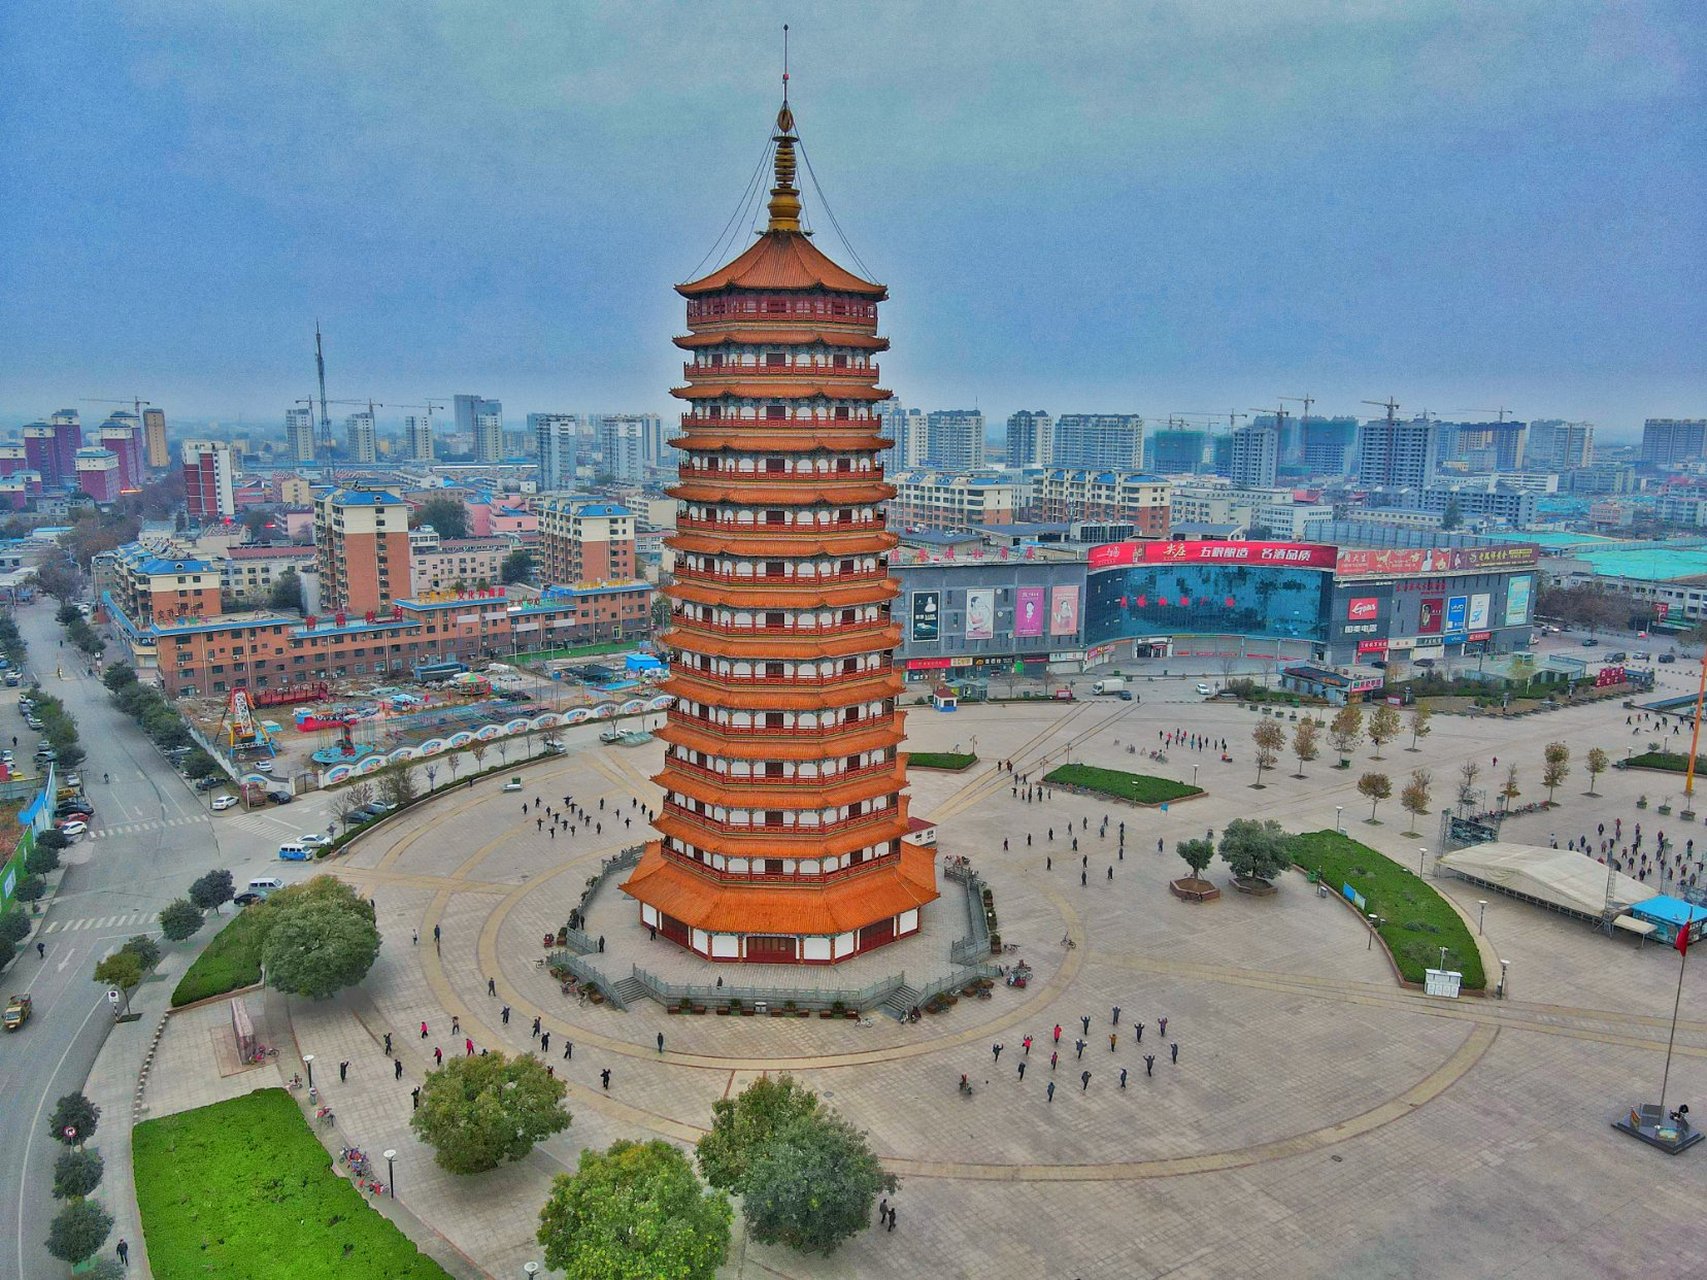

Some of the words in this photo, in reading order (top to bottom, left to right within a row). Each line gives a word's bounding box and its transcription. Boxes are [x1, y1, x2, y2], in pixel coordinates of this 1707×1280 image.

[1163, 543, 1187, 558] 尖庄
[1261, 547, 1312, 562] 名酒品质
[1344, 624, 1378, 634] 国美电器
